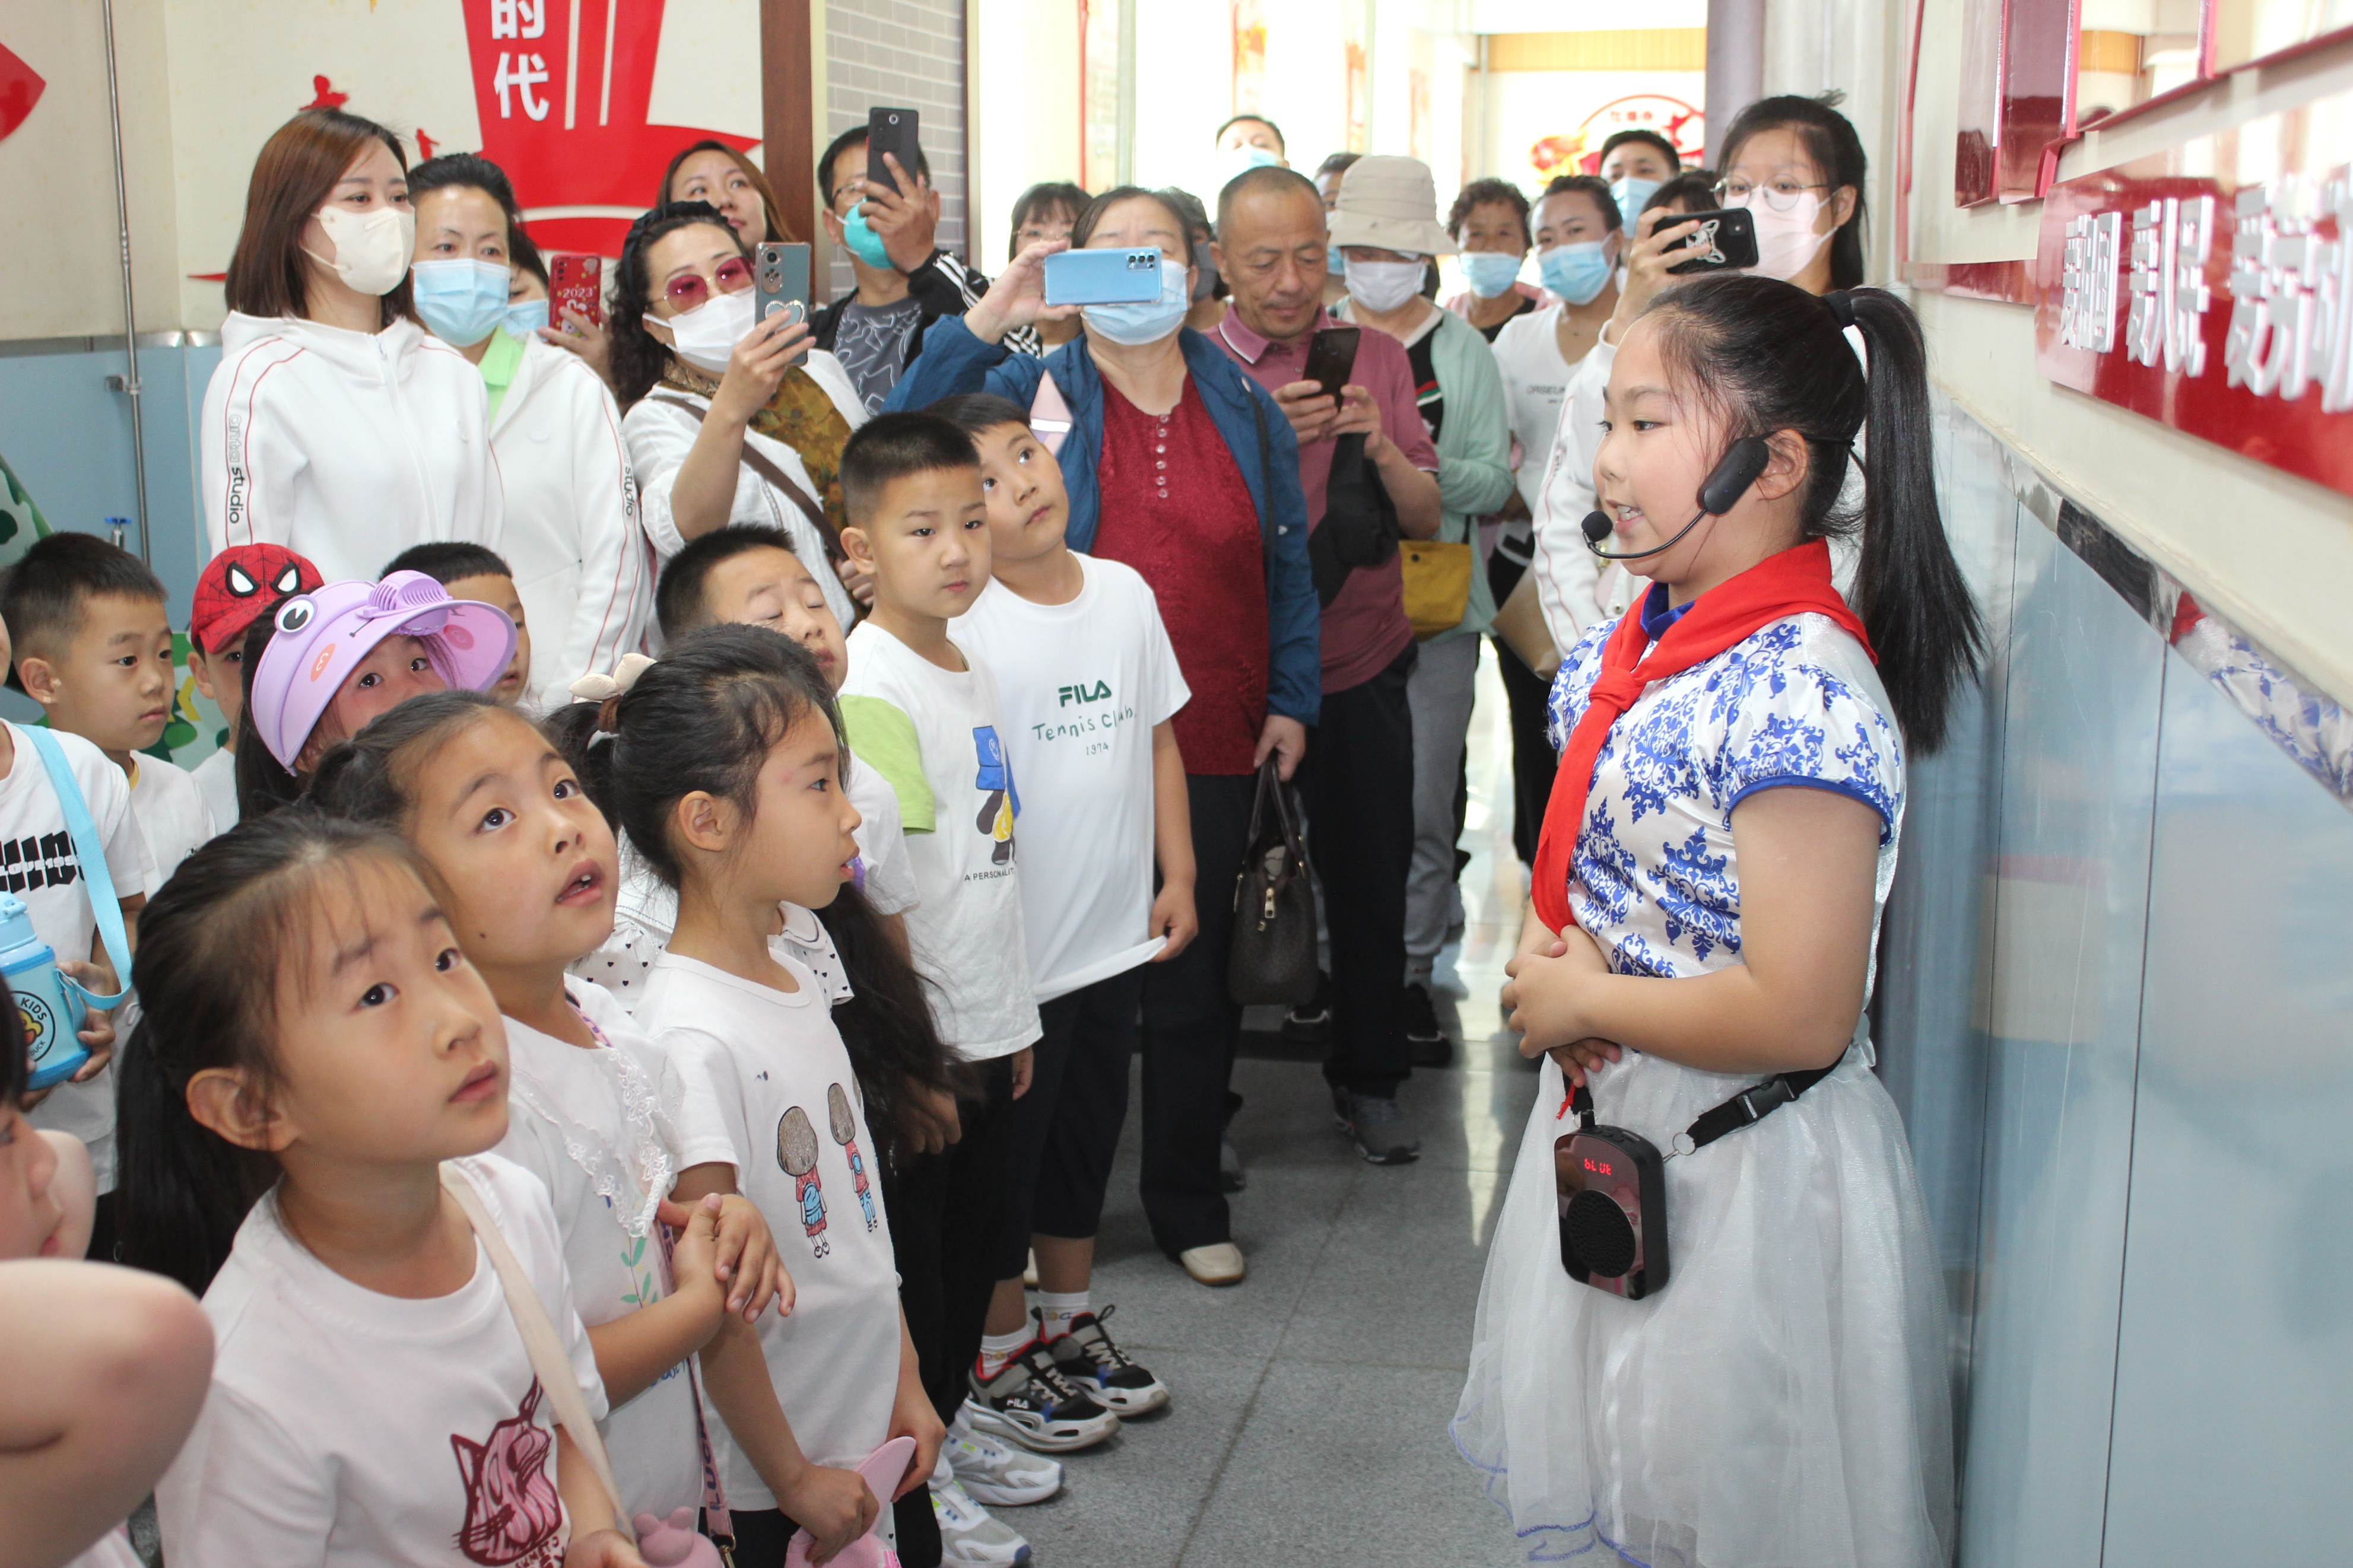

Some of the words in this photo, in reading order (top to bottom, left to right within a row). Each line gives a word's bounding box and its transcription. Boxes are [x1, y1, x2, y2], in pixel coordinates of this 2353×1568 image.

[563, 287, 593, 298] 2023
[228, 414, 242, 463] anta
[229, 466, 246, 524] studio
[623, 466, 635, 517] studio
[1058, 679, 1112, 708] FILA
[1031, 715, 1095, 741] Tennis
[1086, 742, 1109, 756] 1974
[20, 997, 47, 1020] KIDS
[1006, 1397, 1029, 1409] FILA
